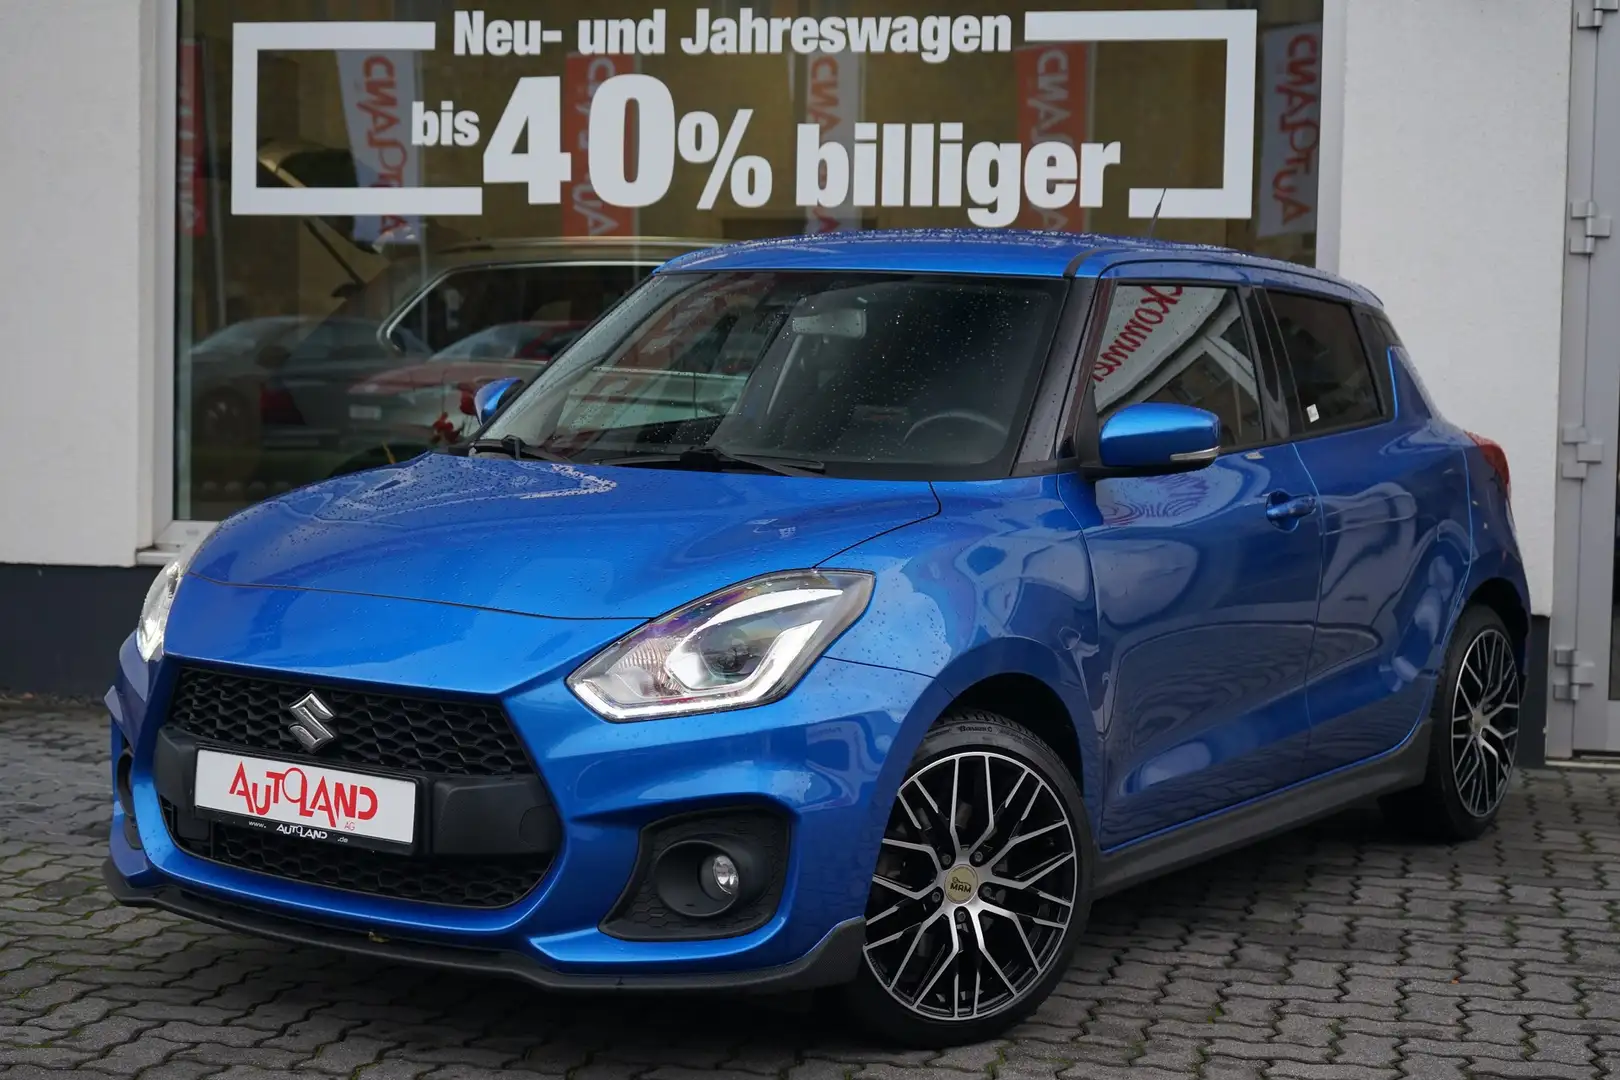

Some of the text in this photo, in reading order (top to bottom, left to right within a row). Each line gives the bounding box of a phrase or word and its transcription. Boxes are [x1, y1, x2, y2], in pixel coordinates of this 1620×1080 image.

[455, 9, 1012, 63] Neu- und Jahreswagen
[411, 101, 480, 146] bis
[484, 75, 773, 210] 40%
[796, 123, 1121, 228] billiger
[228, 760, 379, 828] AUTOLAND
[276, 823, 328, 840] AUTOLAND
